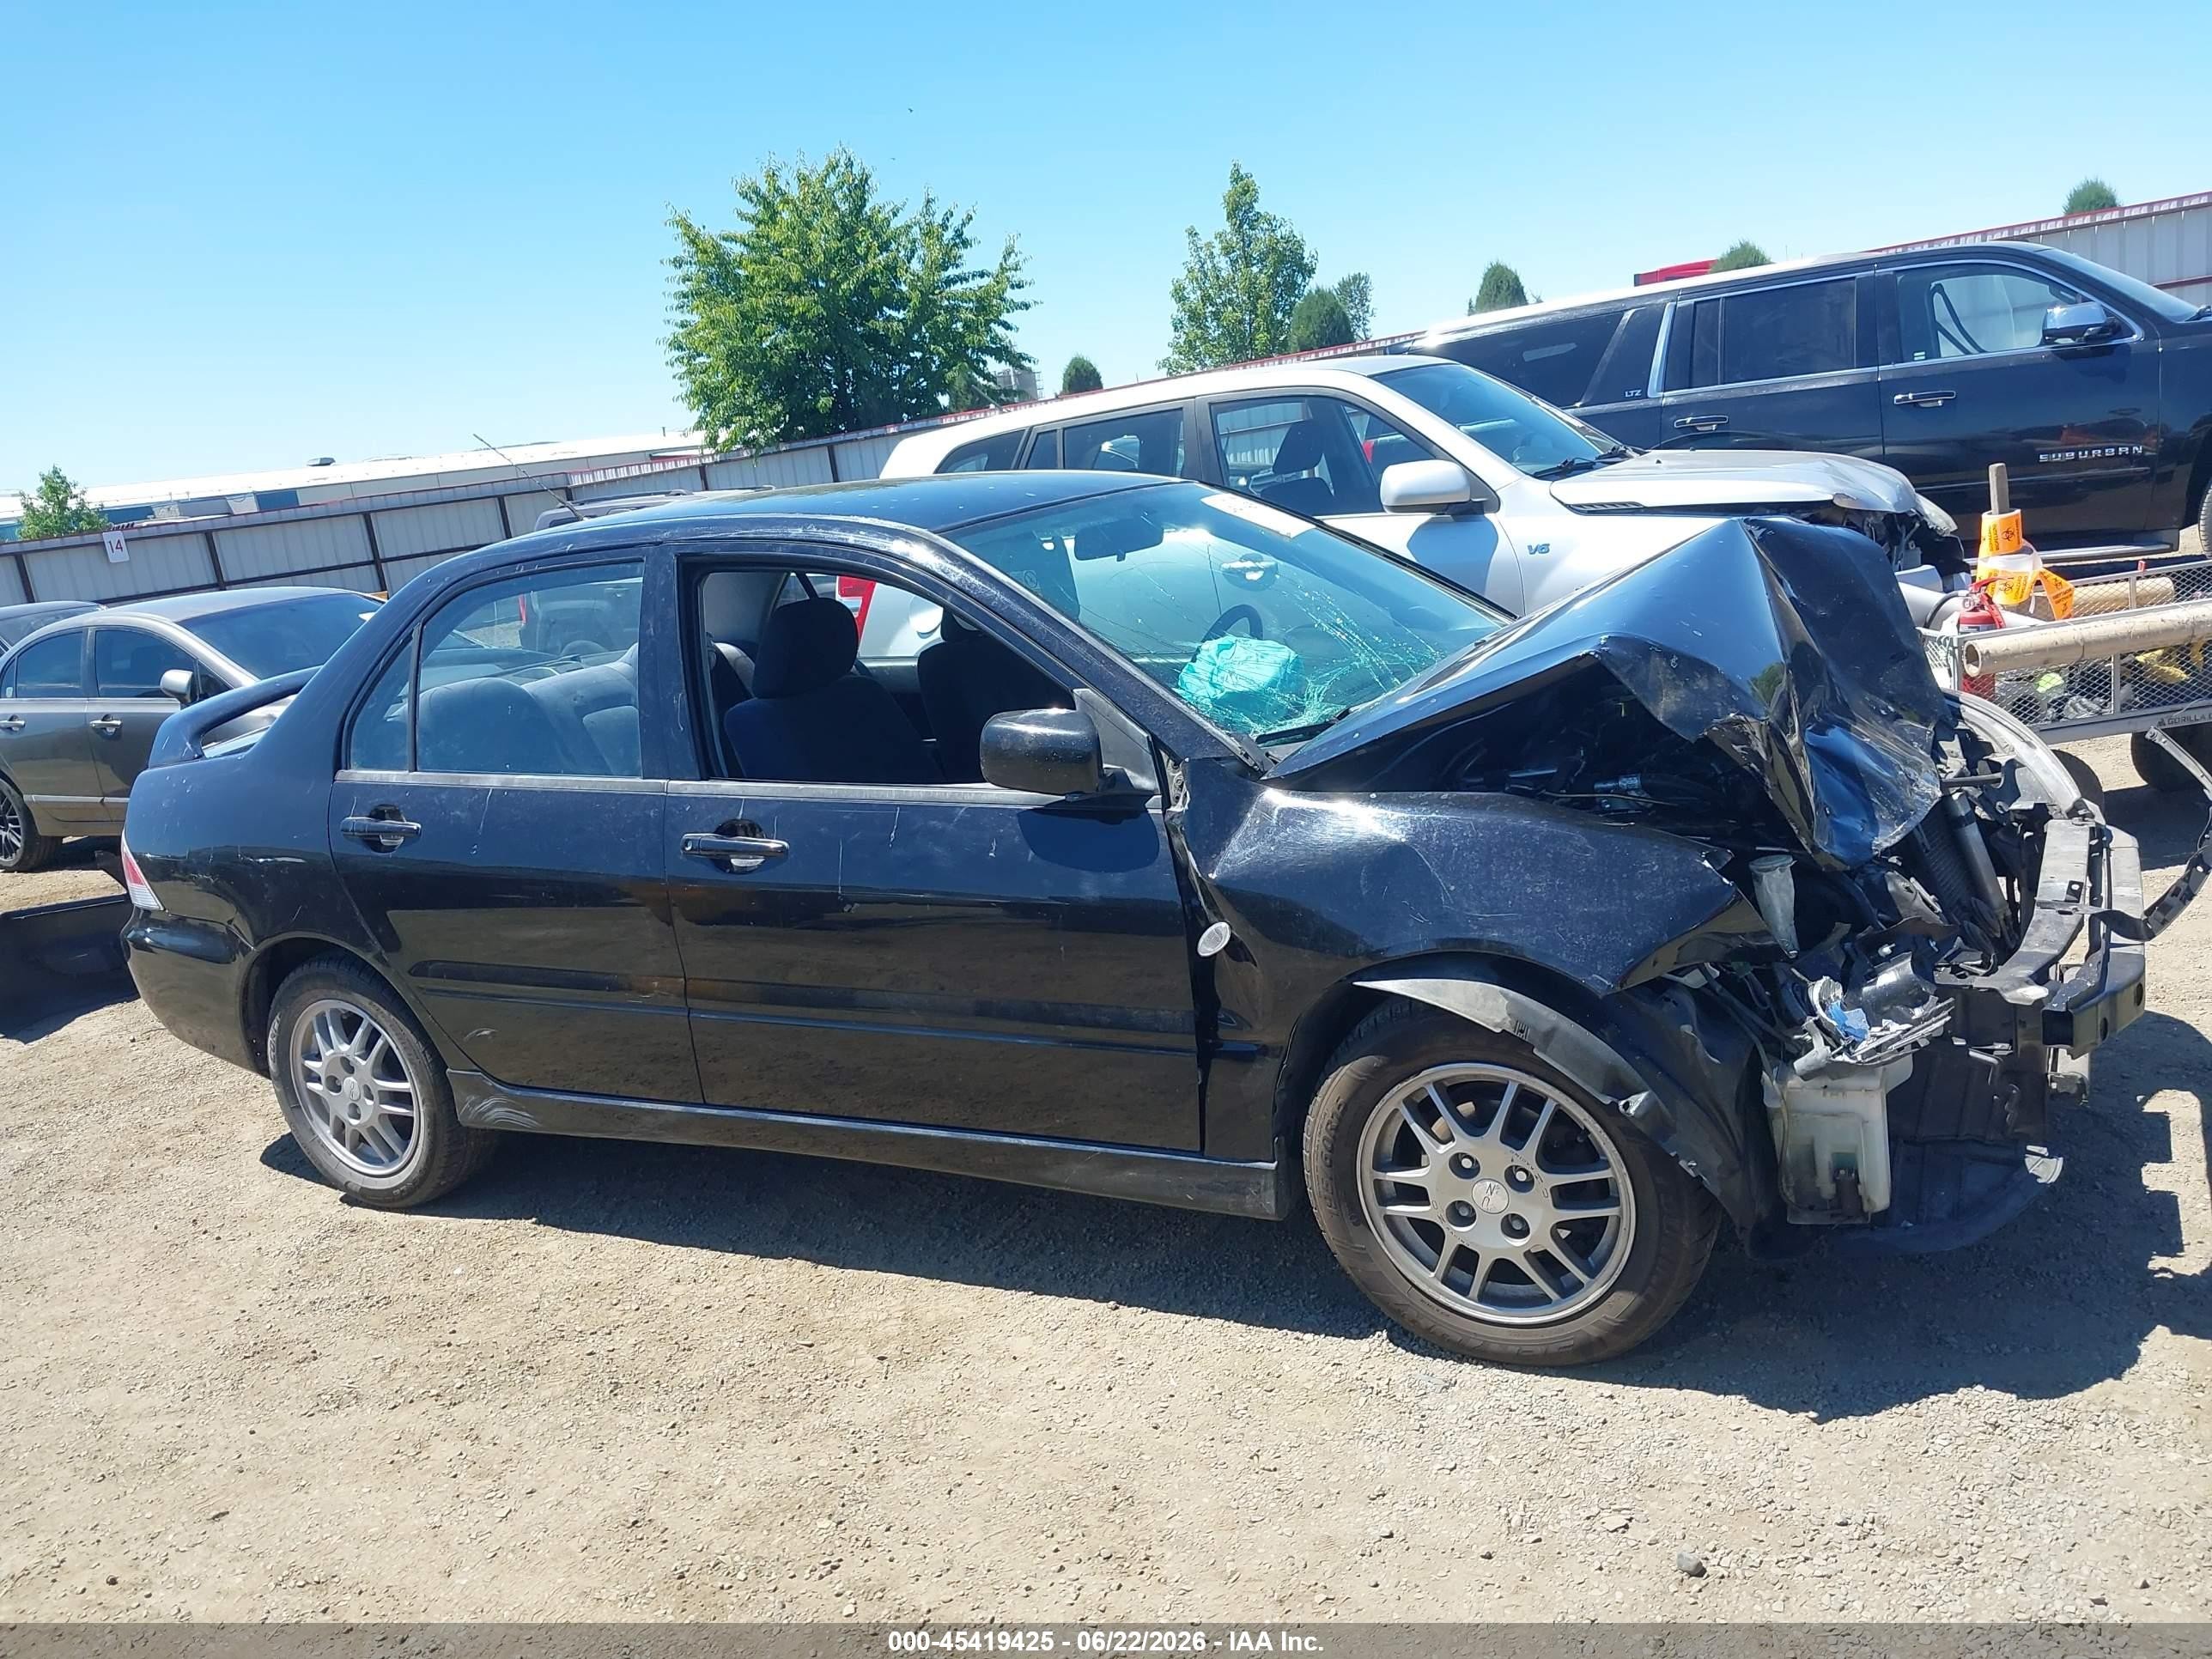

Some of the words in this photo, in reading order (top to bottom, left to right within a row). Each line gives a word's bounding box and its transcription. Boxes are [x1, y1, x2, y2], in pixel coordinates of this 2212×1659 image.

[1625, 389, 1642, 398] LTZ
[2039, 446, 2143, 463] SUBURBAN
[107, 539, 124, 554] 14
[1527, 543, 1551, 556] V6
[2166, 714, 2206, 726] GORILLA
